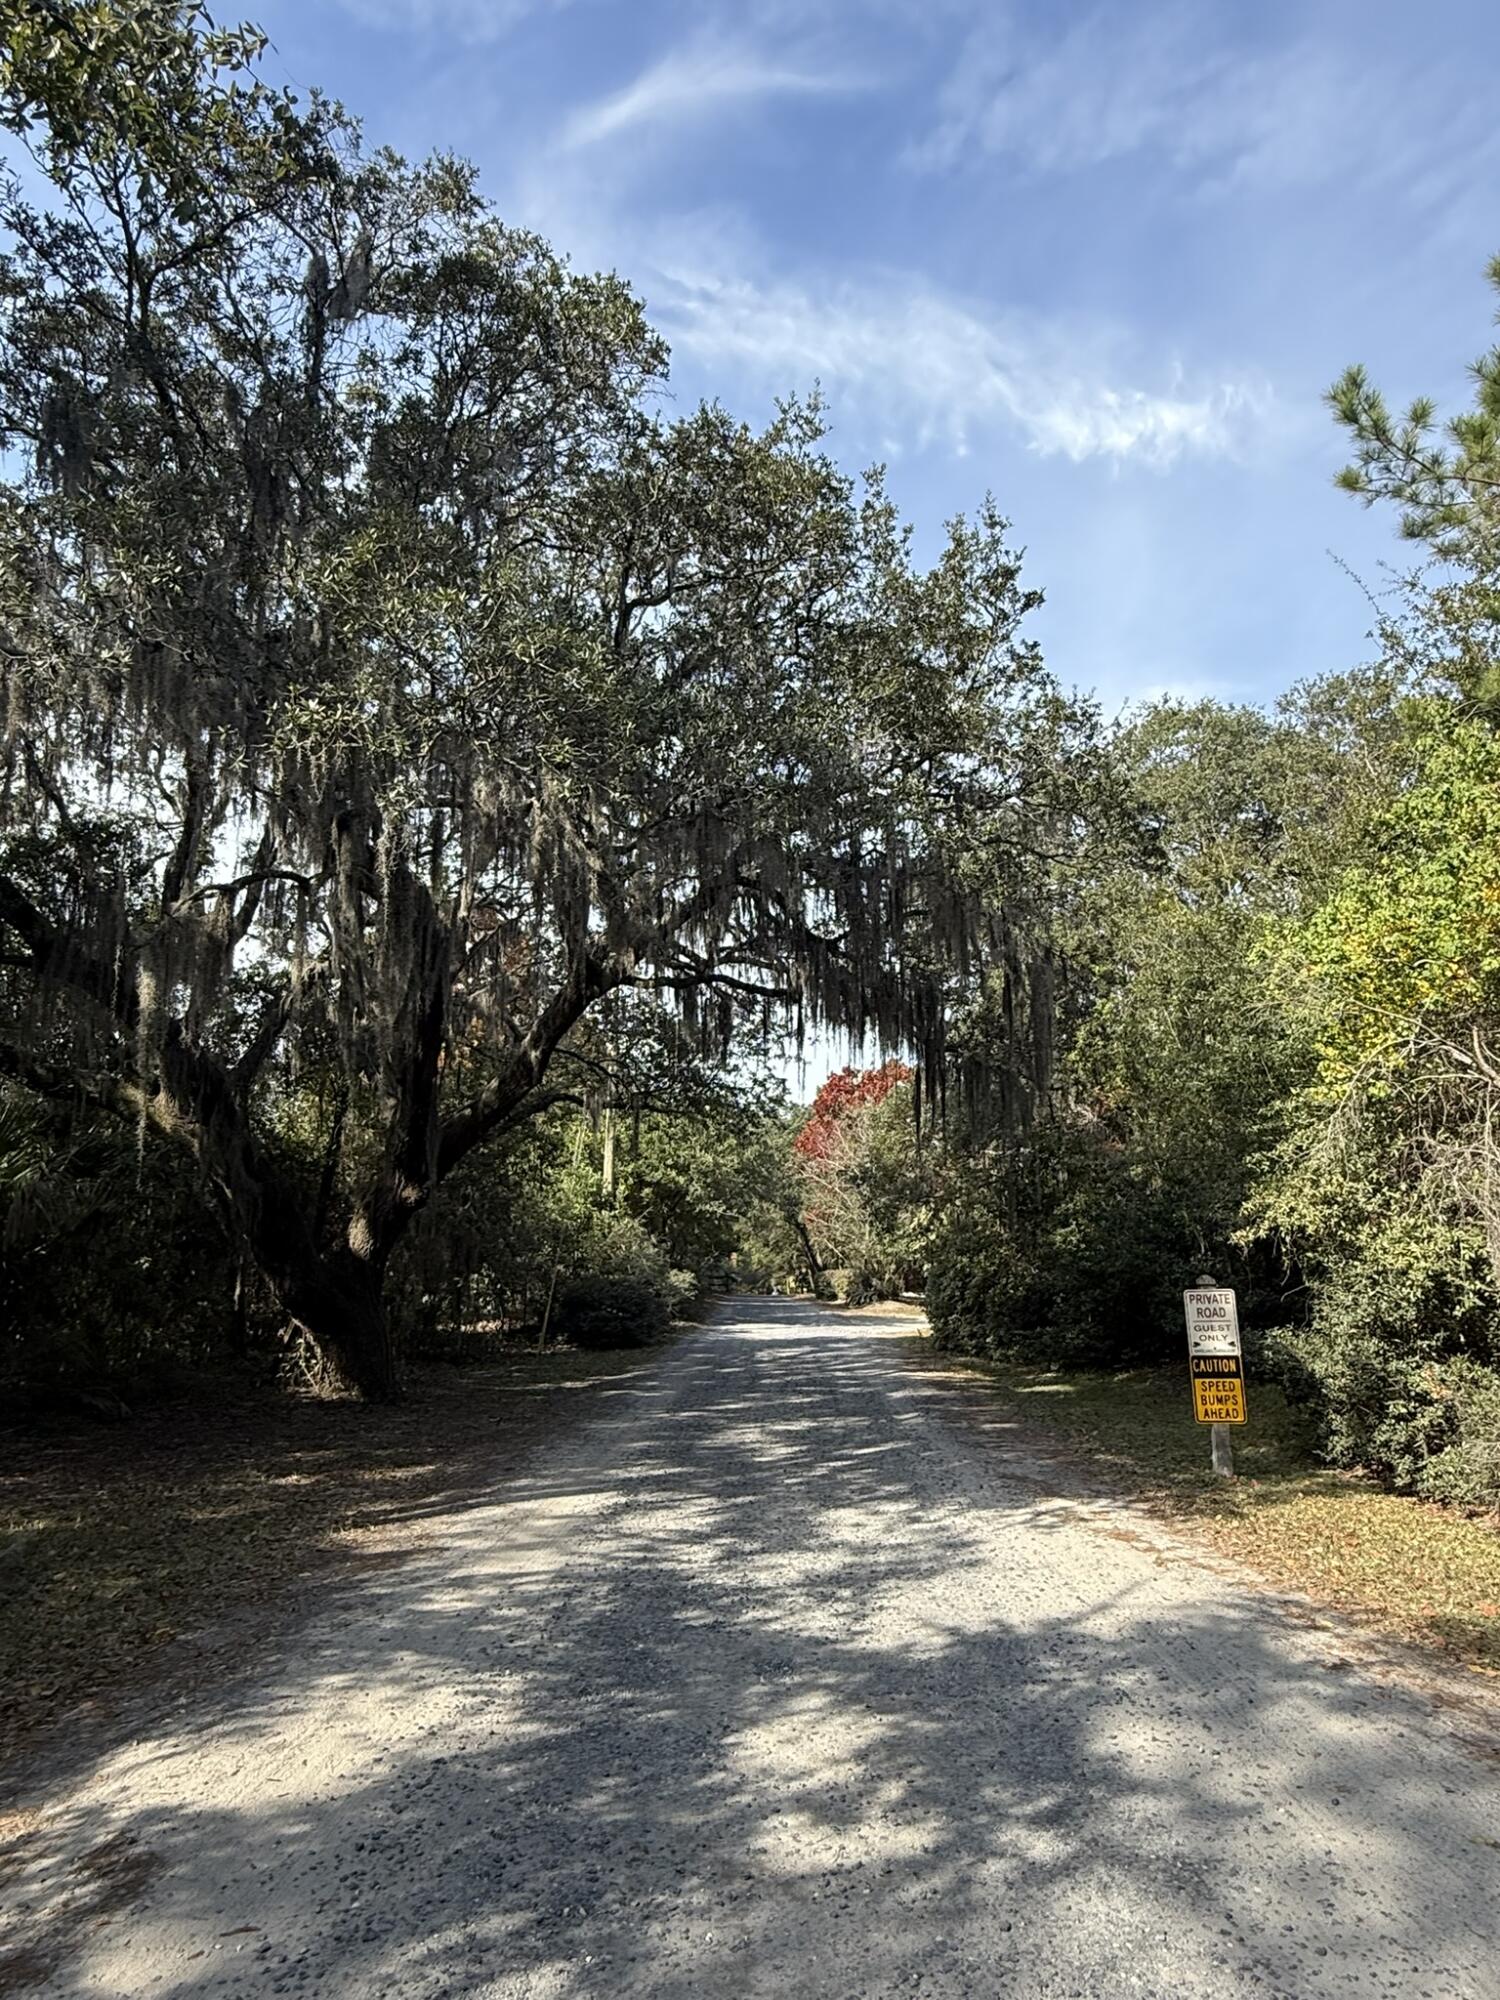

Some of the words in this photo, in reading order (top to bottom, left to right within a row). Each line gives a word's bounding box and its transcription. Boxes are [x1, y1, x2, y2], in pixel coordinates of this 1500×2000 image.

[1189, 1293, 1231, 1304] PRIVATE
[1196, 1307, 1226, 1318] ROAD
[1193, 1324, 1231, 1332] GUEST
[1193, 1359, 1236, 1372] CAUTION
[1201, 1381, 1235, 1392] SPEED
[1201, 1394, 1238, 1406] BUMPS
[1203, 1408, 1239, 1419] AHEAD
